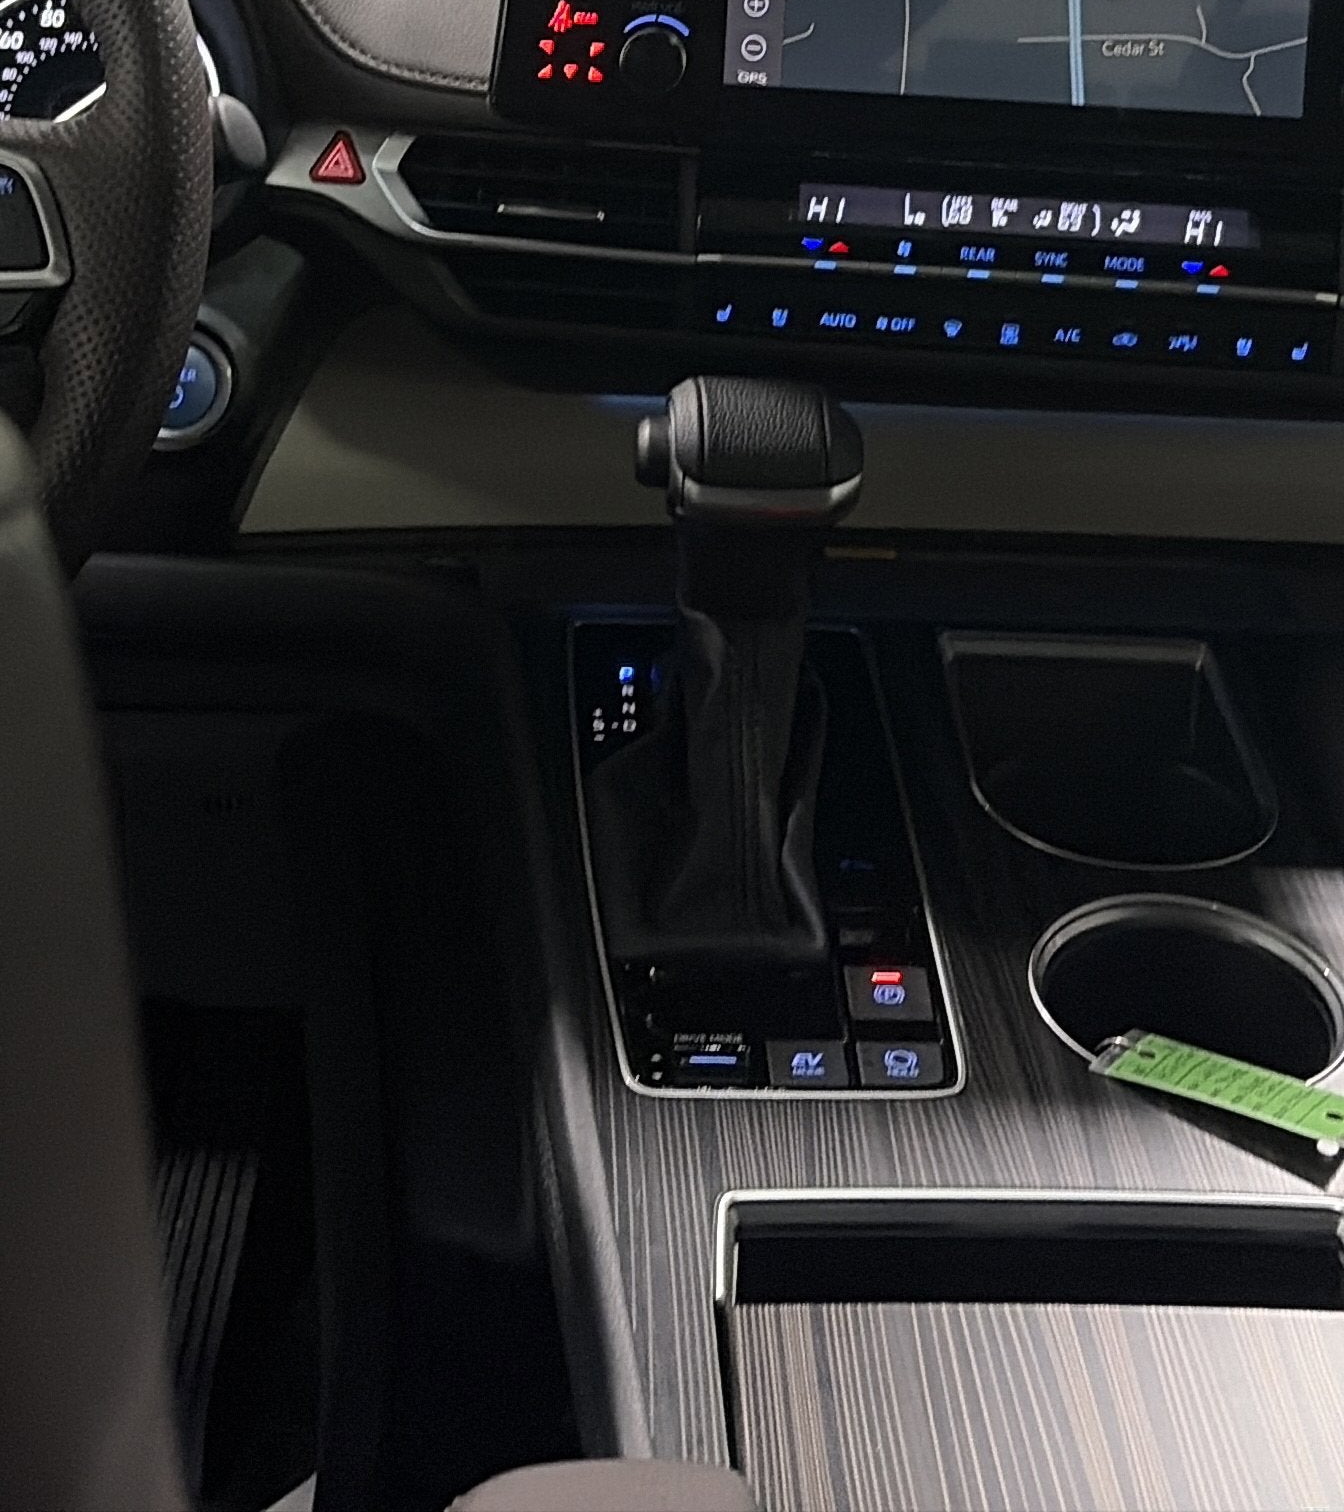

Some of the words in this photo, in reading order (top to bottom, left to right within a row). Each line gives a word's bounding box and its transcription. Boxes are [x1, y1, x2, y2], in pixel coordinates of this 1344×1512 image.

[39, 8, 66, 29] 80
[1101, 40, 1145, 58] Cedar
[1147, 39, 1166, 57] St
[2, 67, 18, 81] 80
[737, 70, 769, 86] GPS
[960, 245, 996, 262] REAR
[1034, 250, 1068, 268] SYNC
[1104, 255, 1145, 273] MODE
[819, 311, 857, 329] AUTO
[890, 317, 916, 332] OFF
[1054, 328, 1081, 343] A/C
[791, 1052, 825, 1066] EV
